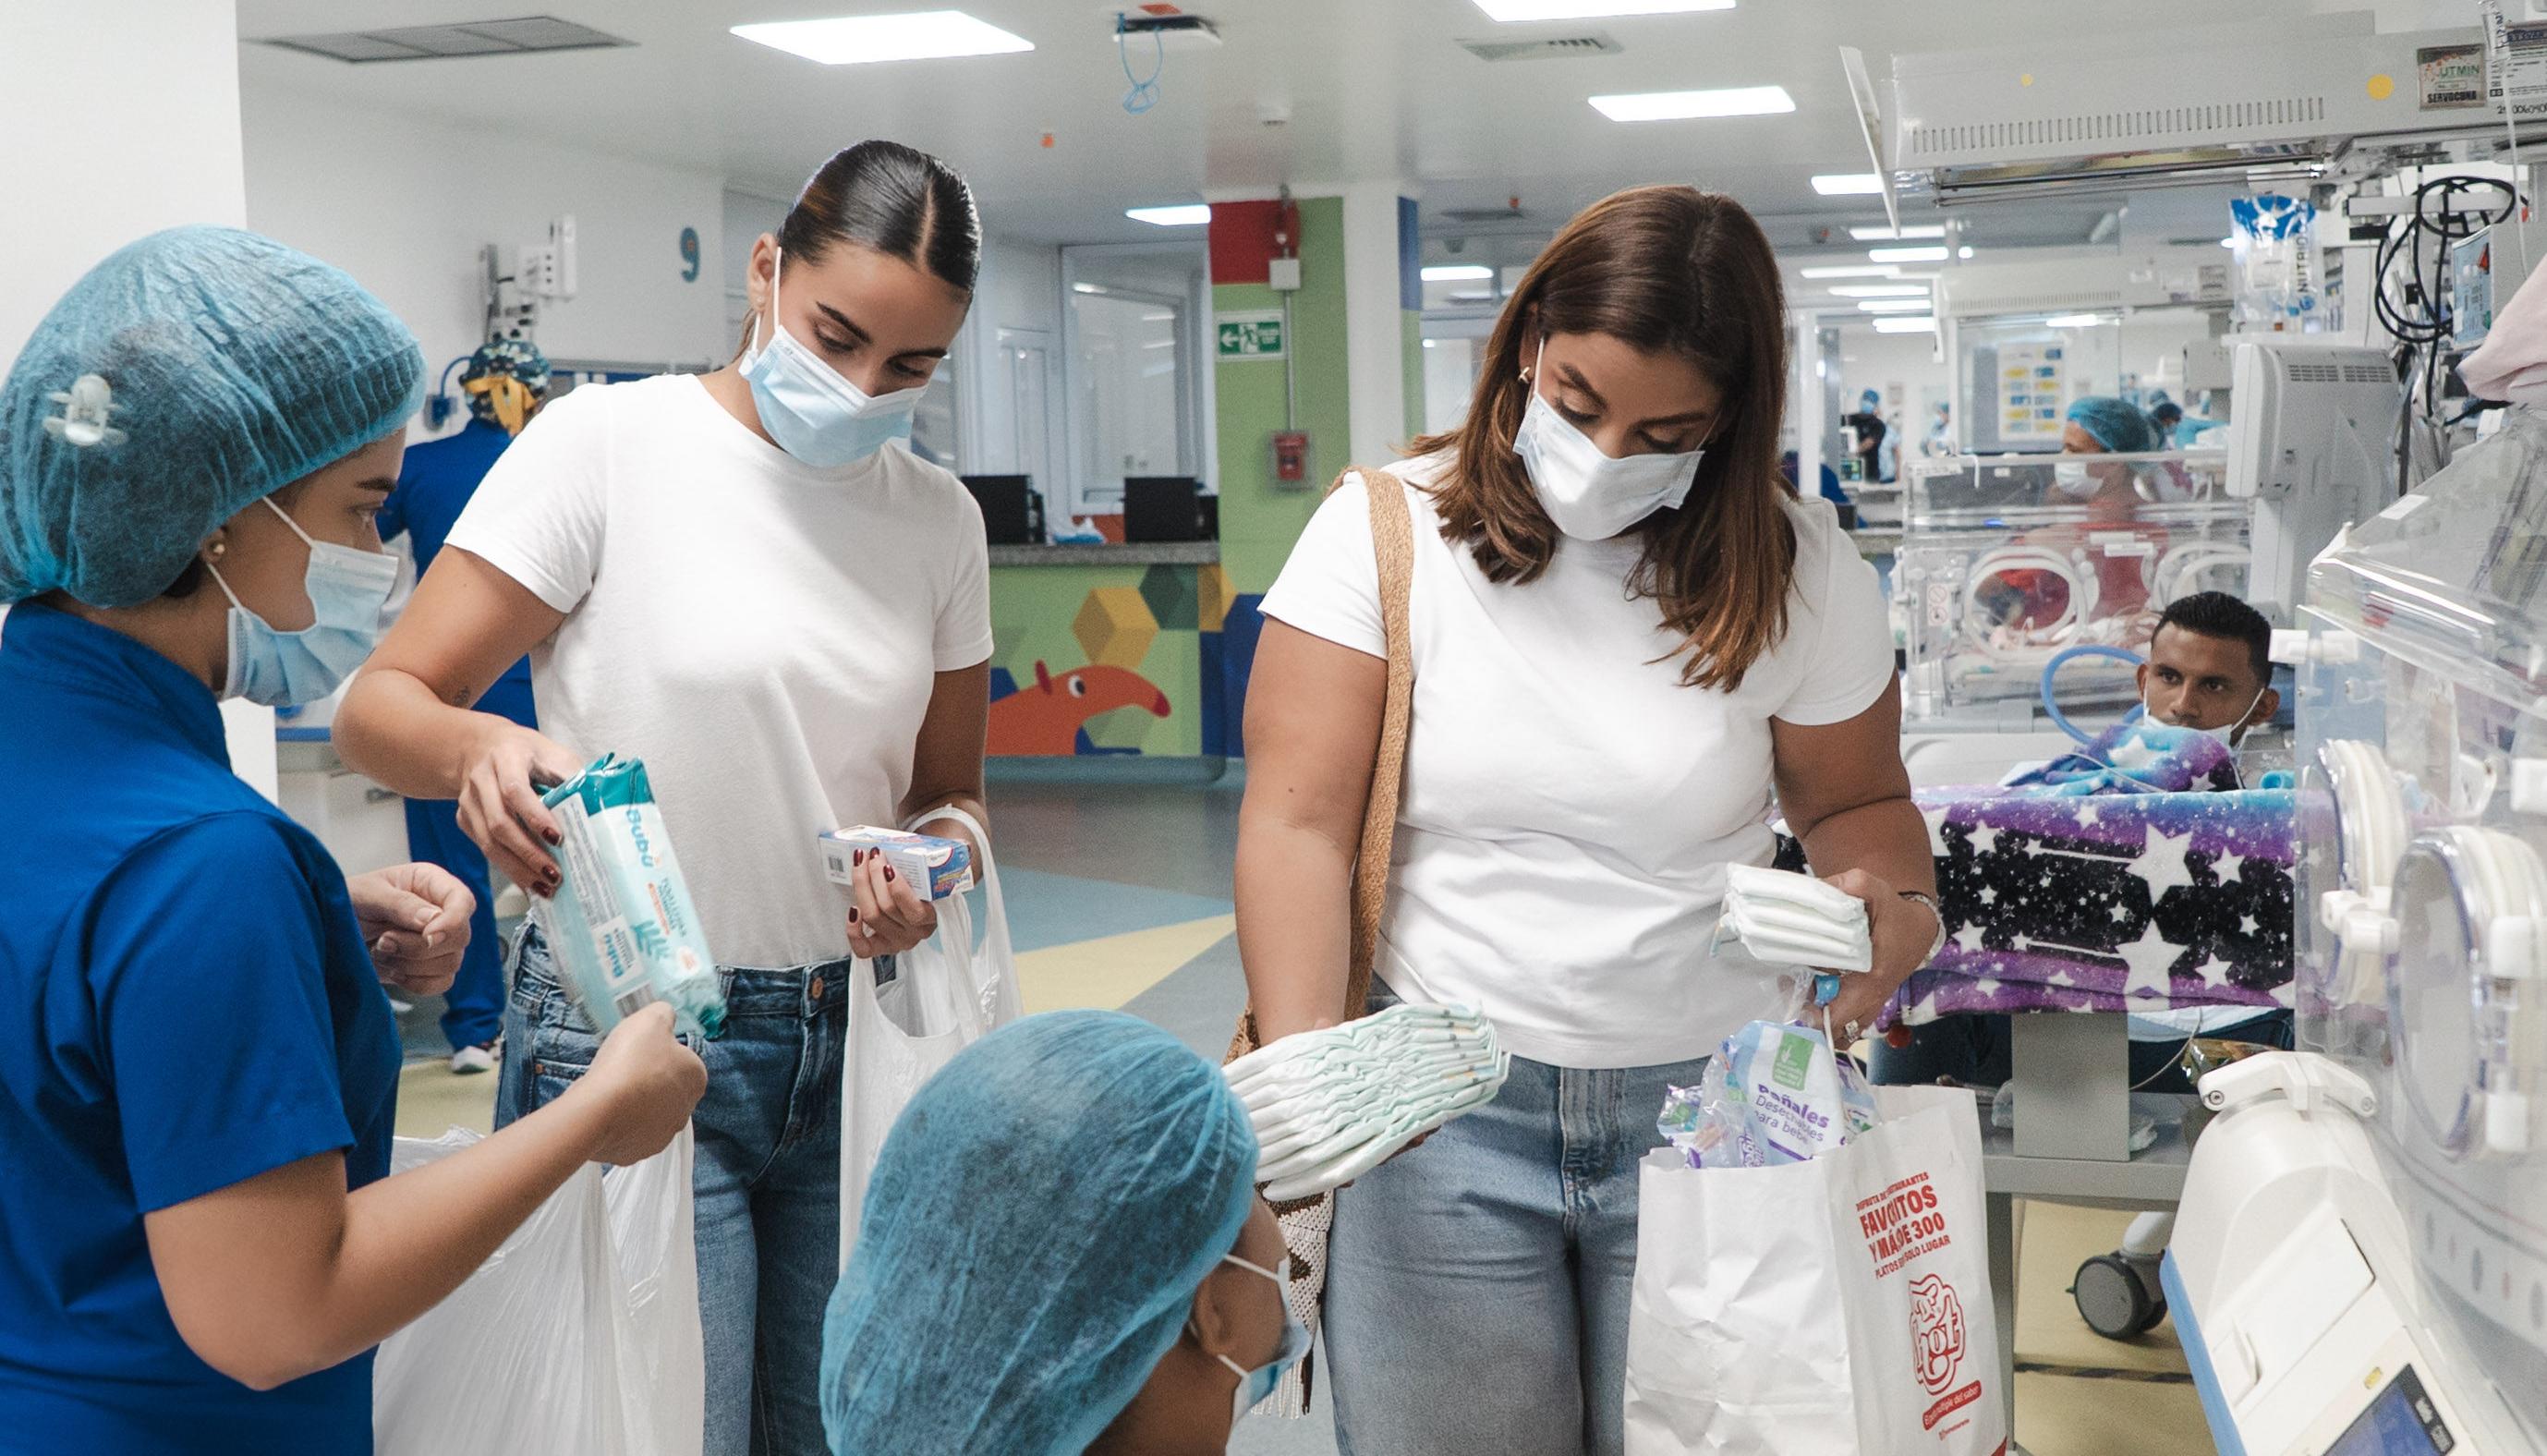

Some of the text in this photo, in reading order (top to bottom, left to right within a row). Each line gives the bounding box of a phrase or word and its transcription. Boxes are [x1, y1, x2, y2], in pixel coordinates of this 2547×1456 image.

[680, 227, 700, 283] 9
[1911, 1212, 1945, 1239] 300
[1922, 1235, 1951, 1254] LUGAR
